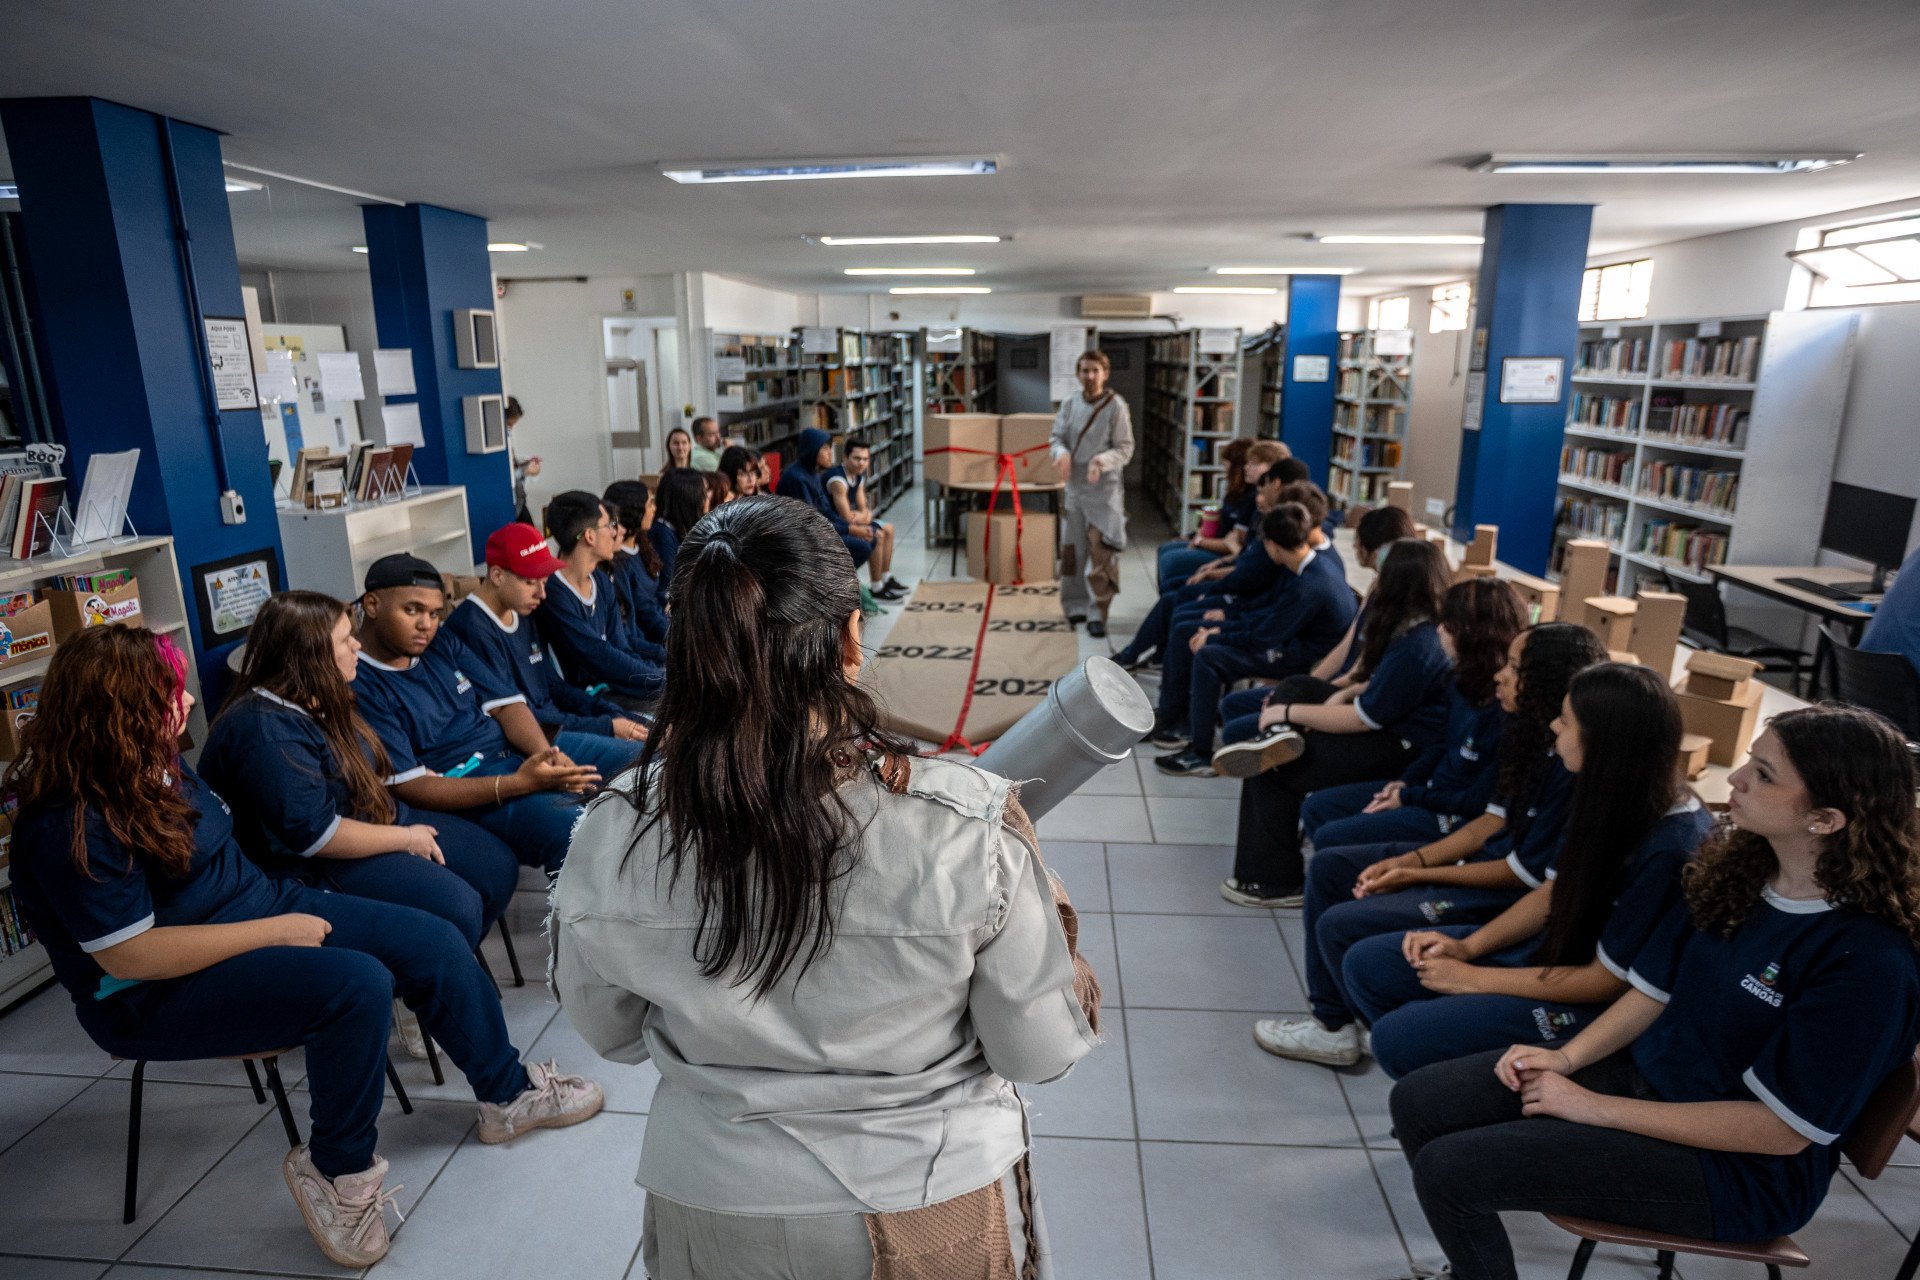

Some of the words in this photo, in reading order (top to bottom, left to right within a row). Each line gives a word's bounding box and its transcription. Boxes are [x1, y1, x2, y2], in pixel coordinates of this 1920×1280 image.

[998, 586, 1059, 596] 202
[110, 601, 137, 617] Magali
[905, 602, 983, 612] 2024
[877, 645, 973, 660] 2022
[973, 678, 1052, 696] 202
[1741, 979, 1781, 1007] CANOAS
